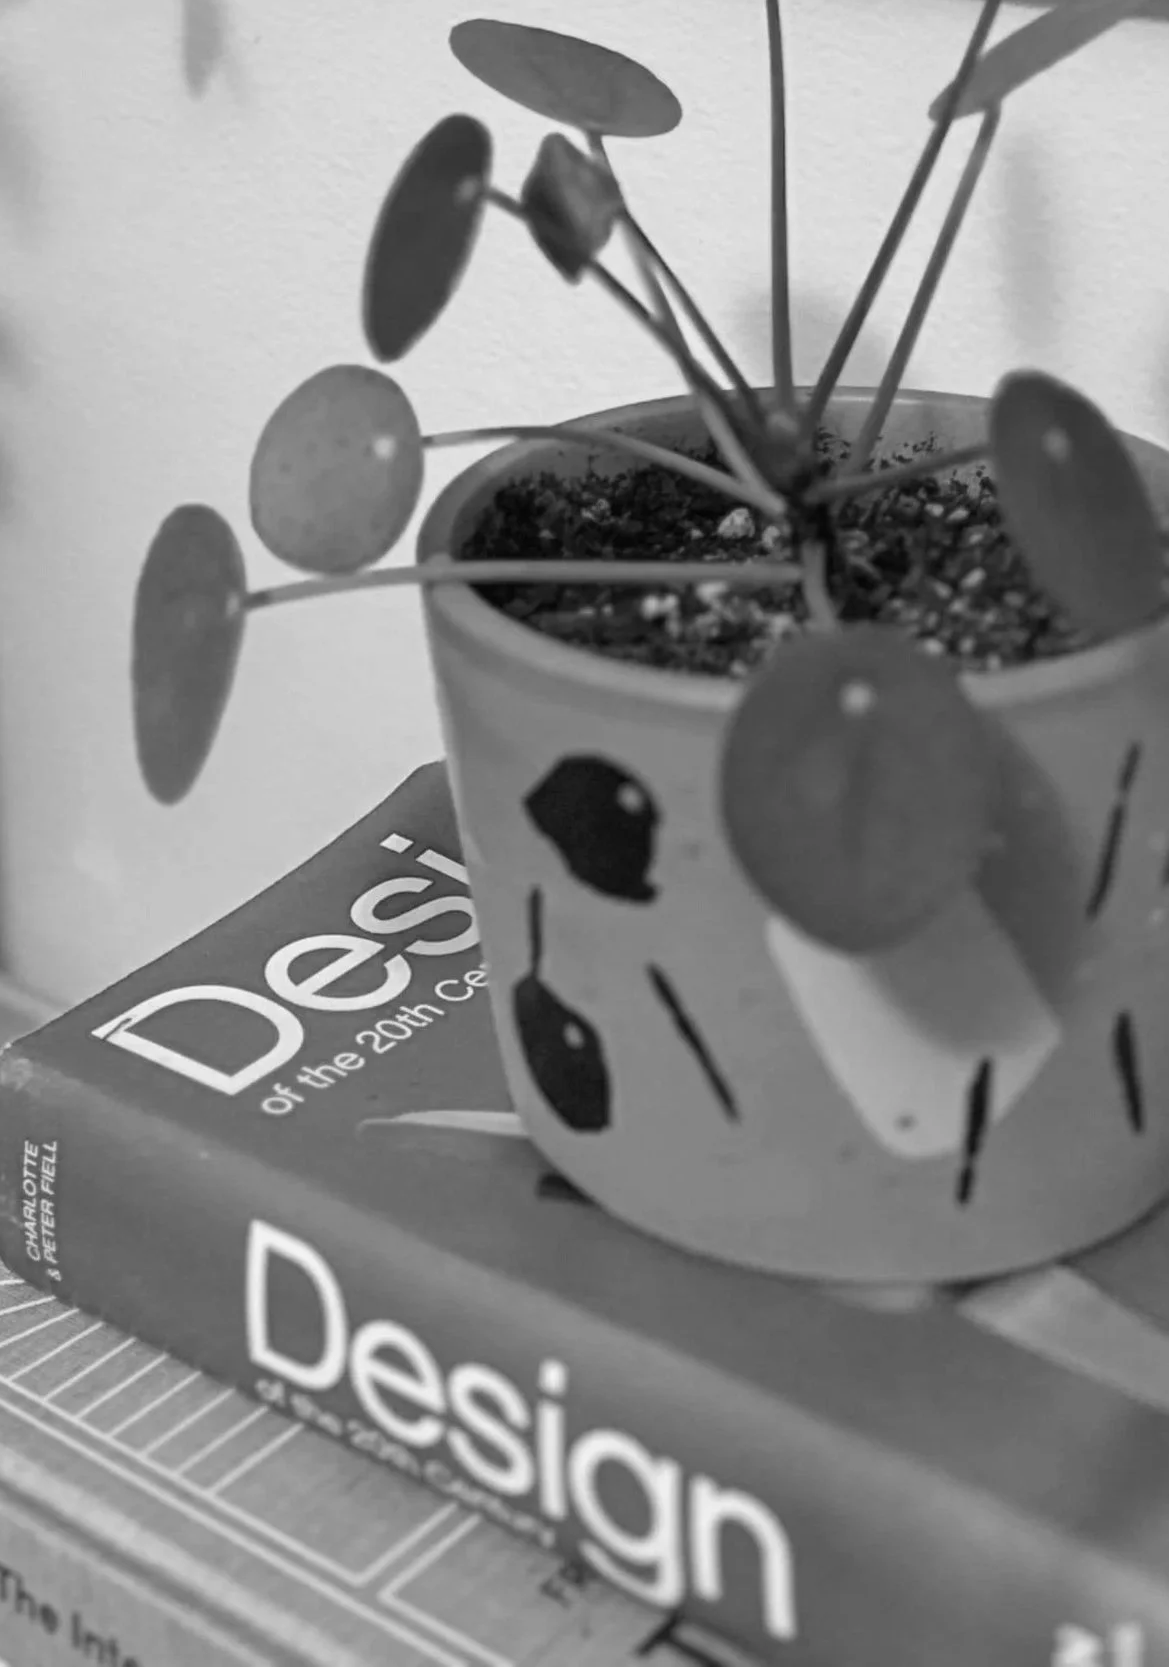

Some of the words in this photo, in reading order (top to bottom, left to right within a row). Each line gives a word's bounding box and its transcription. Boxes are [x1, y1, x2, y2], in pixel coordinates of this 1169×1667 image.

[260, 1082, 305, 1115] of
[296, 1051, 365, 1089] the
[355, 1002, 445, 1054] 20th
[434, 962, 490, 1002] Ce
[22, 1139, 40, 1262] CHARLOTTE
[40, 1140, 58, 1196] FIELL
[40, 1198, 59, 1265] PETER
[46, 1267, 62, 1282] &
[245, 1218, 797, 1640] Design
